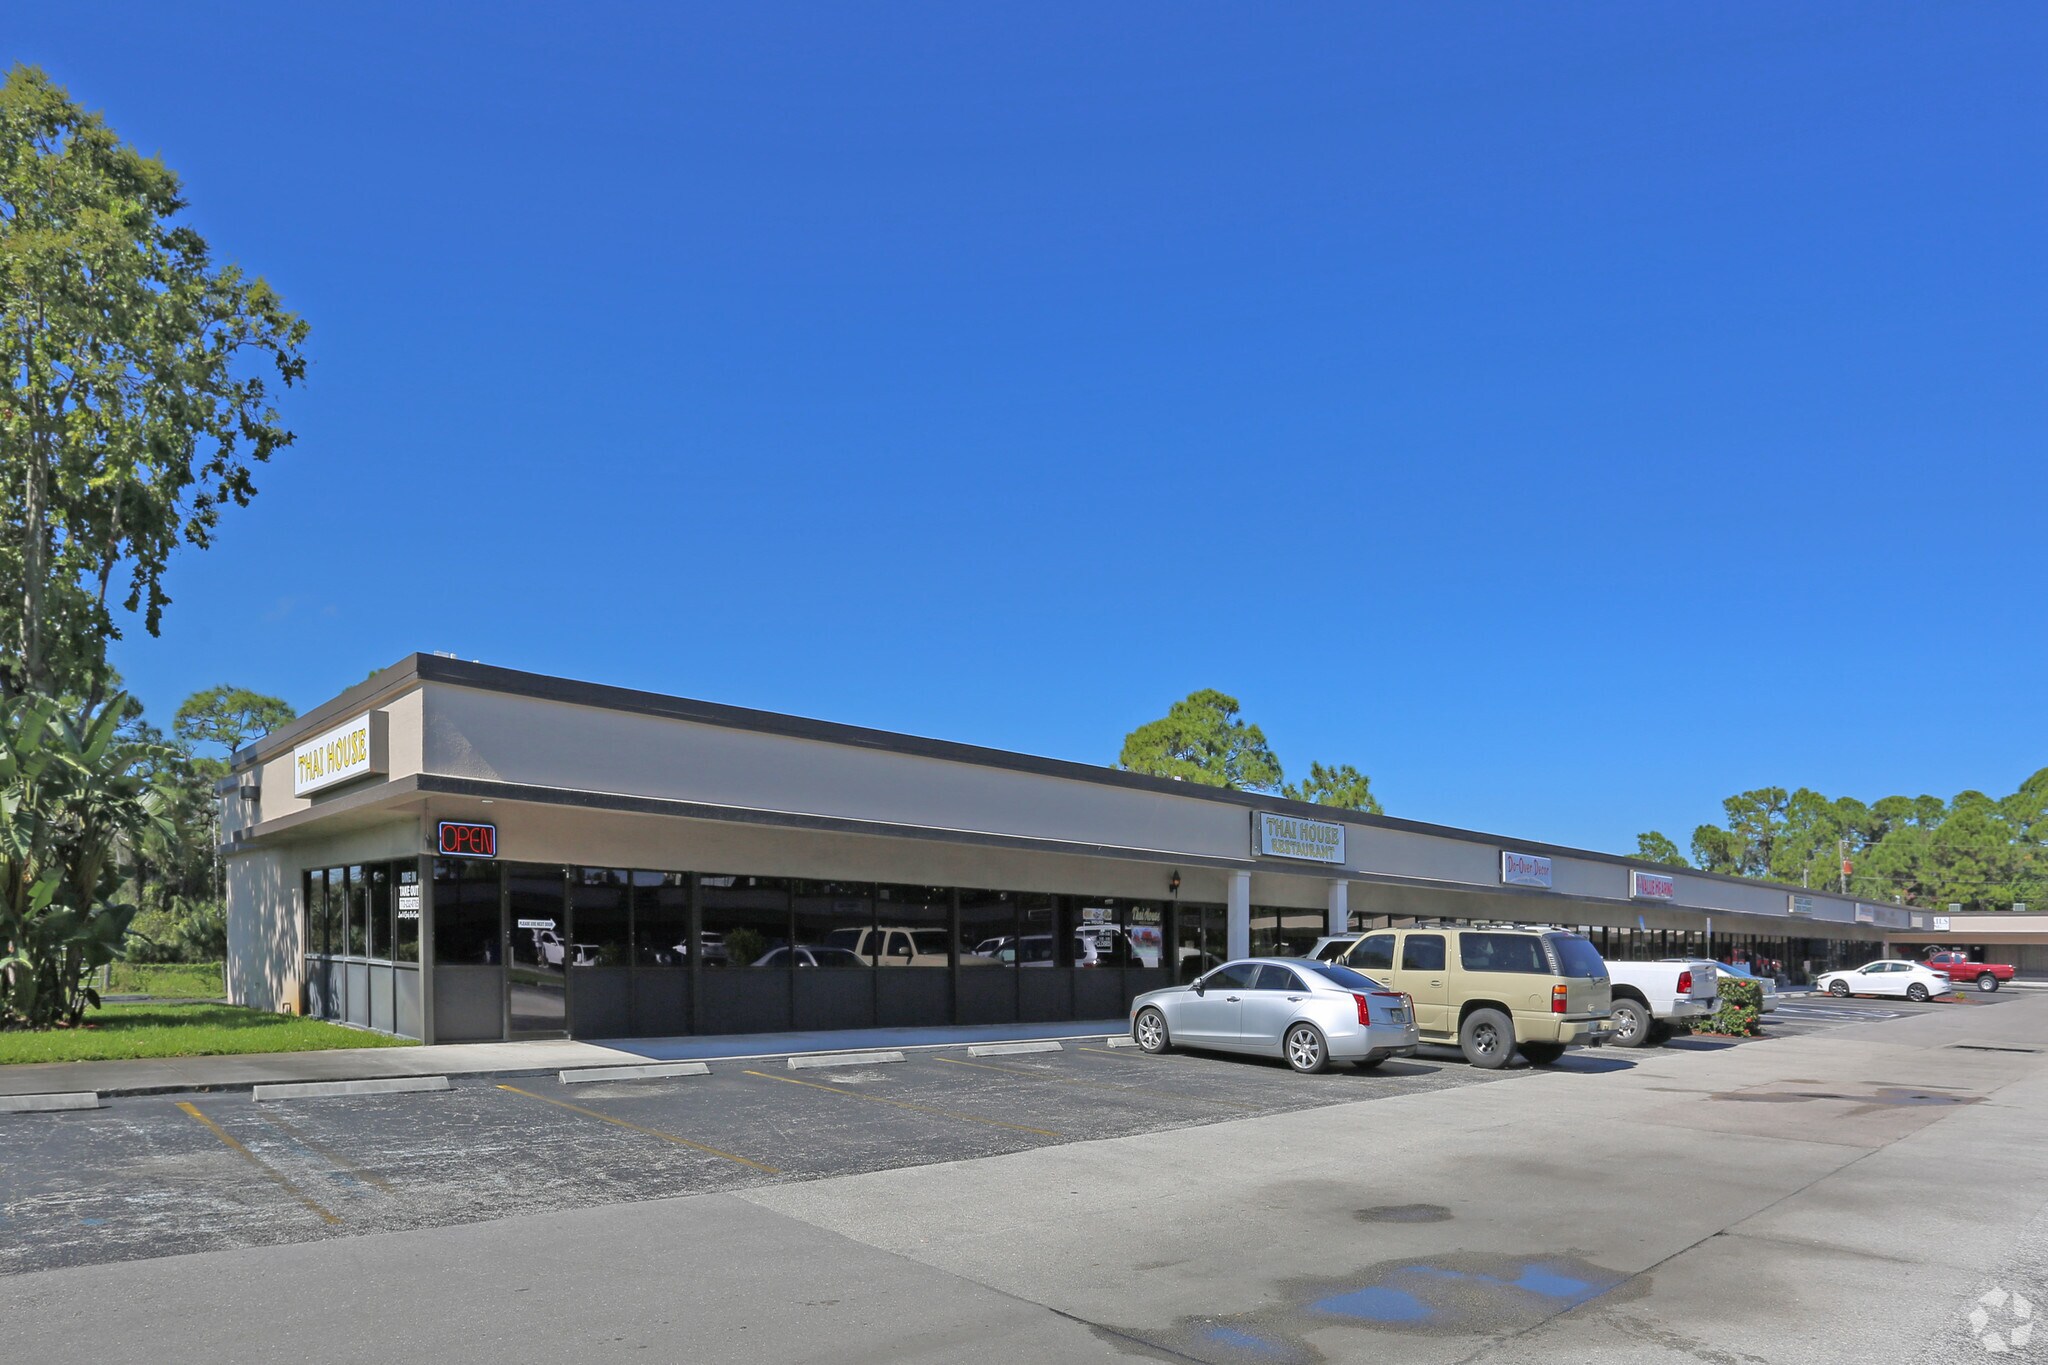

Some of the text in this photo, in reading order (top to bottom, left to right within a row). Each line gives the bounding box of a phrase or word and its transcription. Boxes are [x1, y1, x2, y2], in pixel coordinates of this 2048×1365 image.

[298, 728, 367, 784] THAI HOUSE
[442, 825, 493, 854] OPEN
[1266, 817, 1339, 846] THAI HOUSE
[1271, 838, 1335, 860] RESTAURANT
